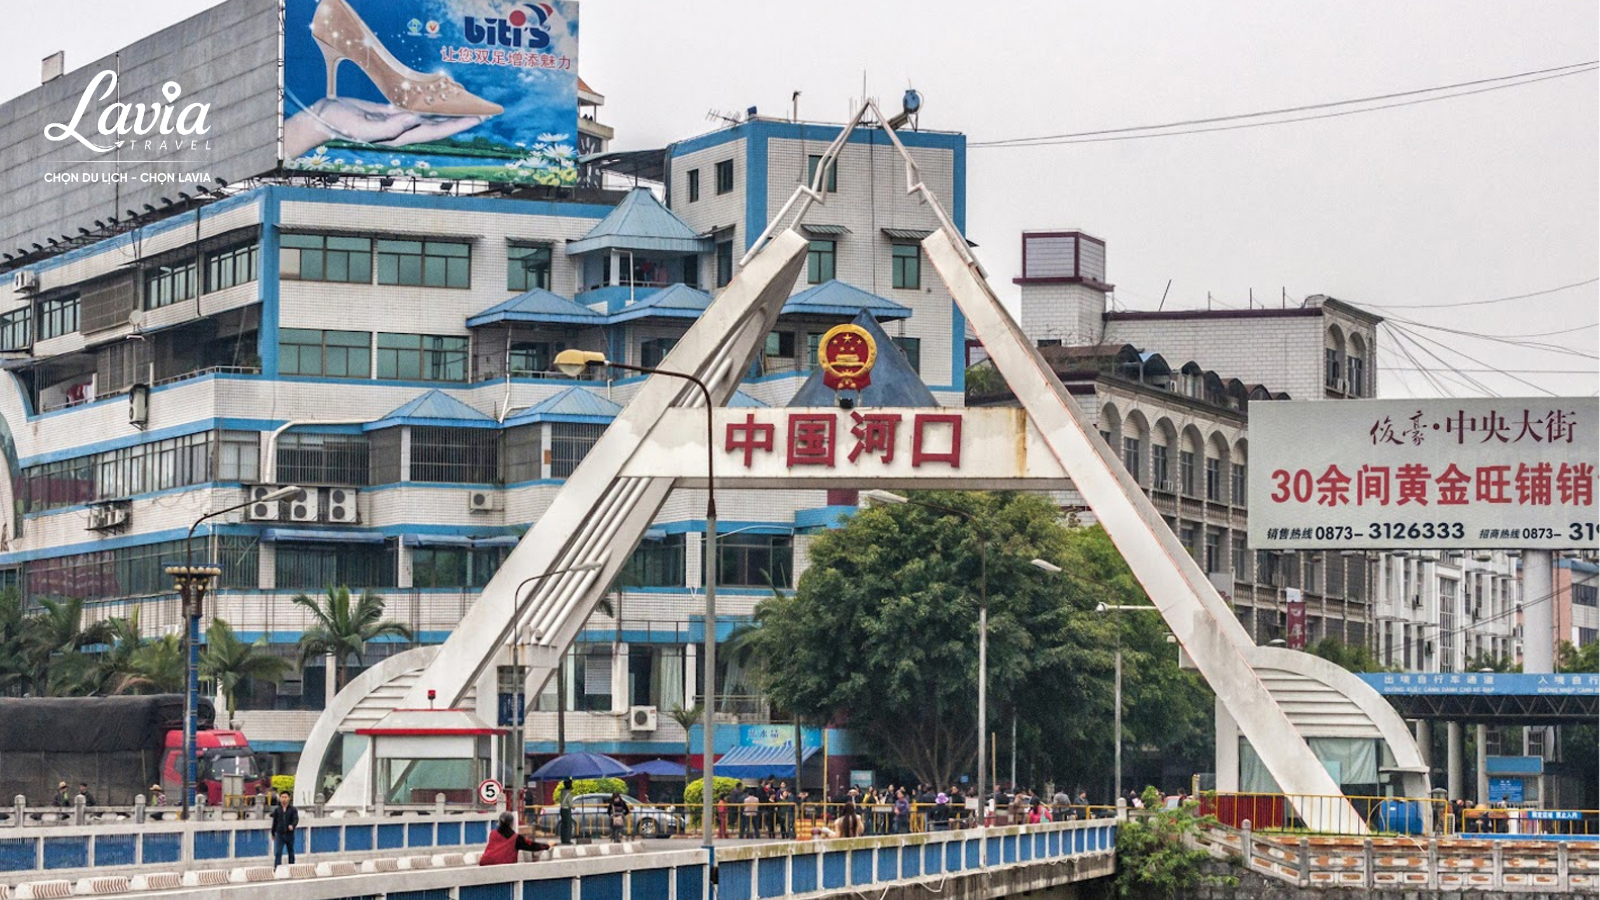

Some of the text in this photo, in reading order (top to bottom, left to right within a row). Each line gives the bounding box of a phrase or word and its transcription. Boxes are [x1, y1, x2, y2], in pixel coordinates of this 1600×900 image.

[440, 46, 571, 70] 让您双足增添魅力
[725, 411, 962, 468] 中国河口
[1271, 462, 1599, 507] 30余间黄金旺铺销
[1267, 527, 1313, 540] 销售热线
[1368, 522, 1465, 540] 3126333
[1479, 528, 1520, 539] 招商热线
[486, 784, 496, 798] 5
